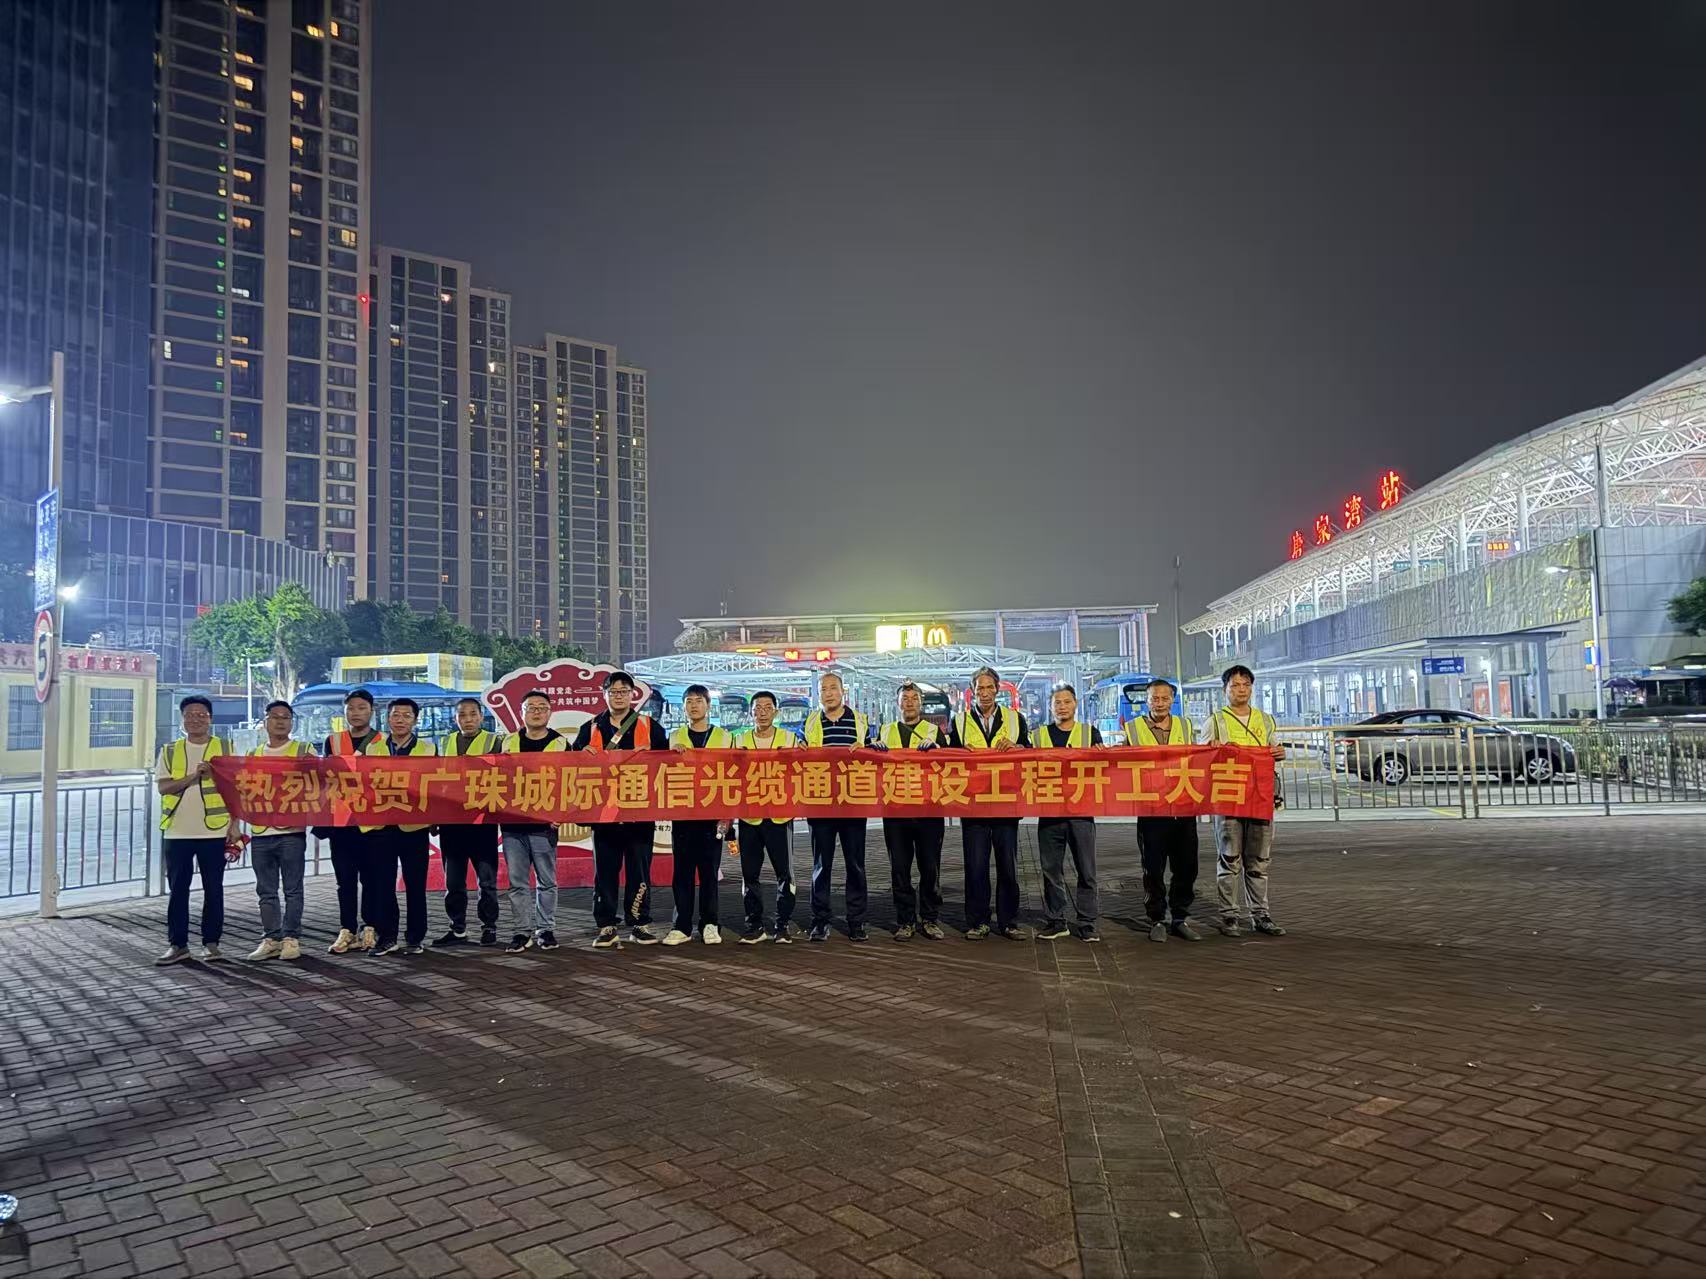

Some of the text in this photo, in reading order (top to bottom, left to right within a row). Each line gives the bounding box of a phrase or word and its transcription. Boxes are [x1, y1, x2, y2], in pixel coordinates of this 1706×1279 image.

[1291, 470, 1400, 559] 唐家湾站
[38, 633, 47, 680] 5
[557, 697, 599, 706] 共筑中国梦
[235, 757, 1251, 813] 热烈祝贺广珠城际通信光缆通道建设工程开工大吉
